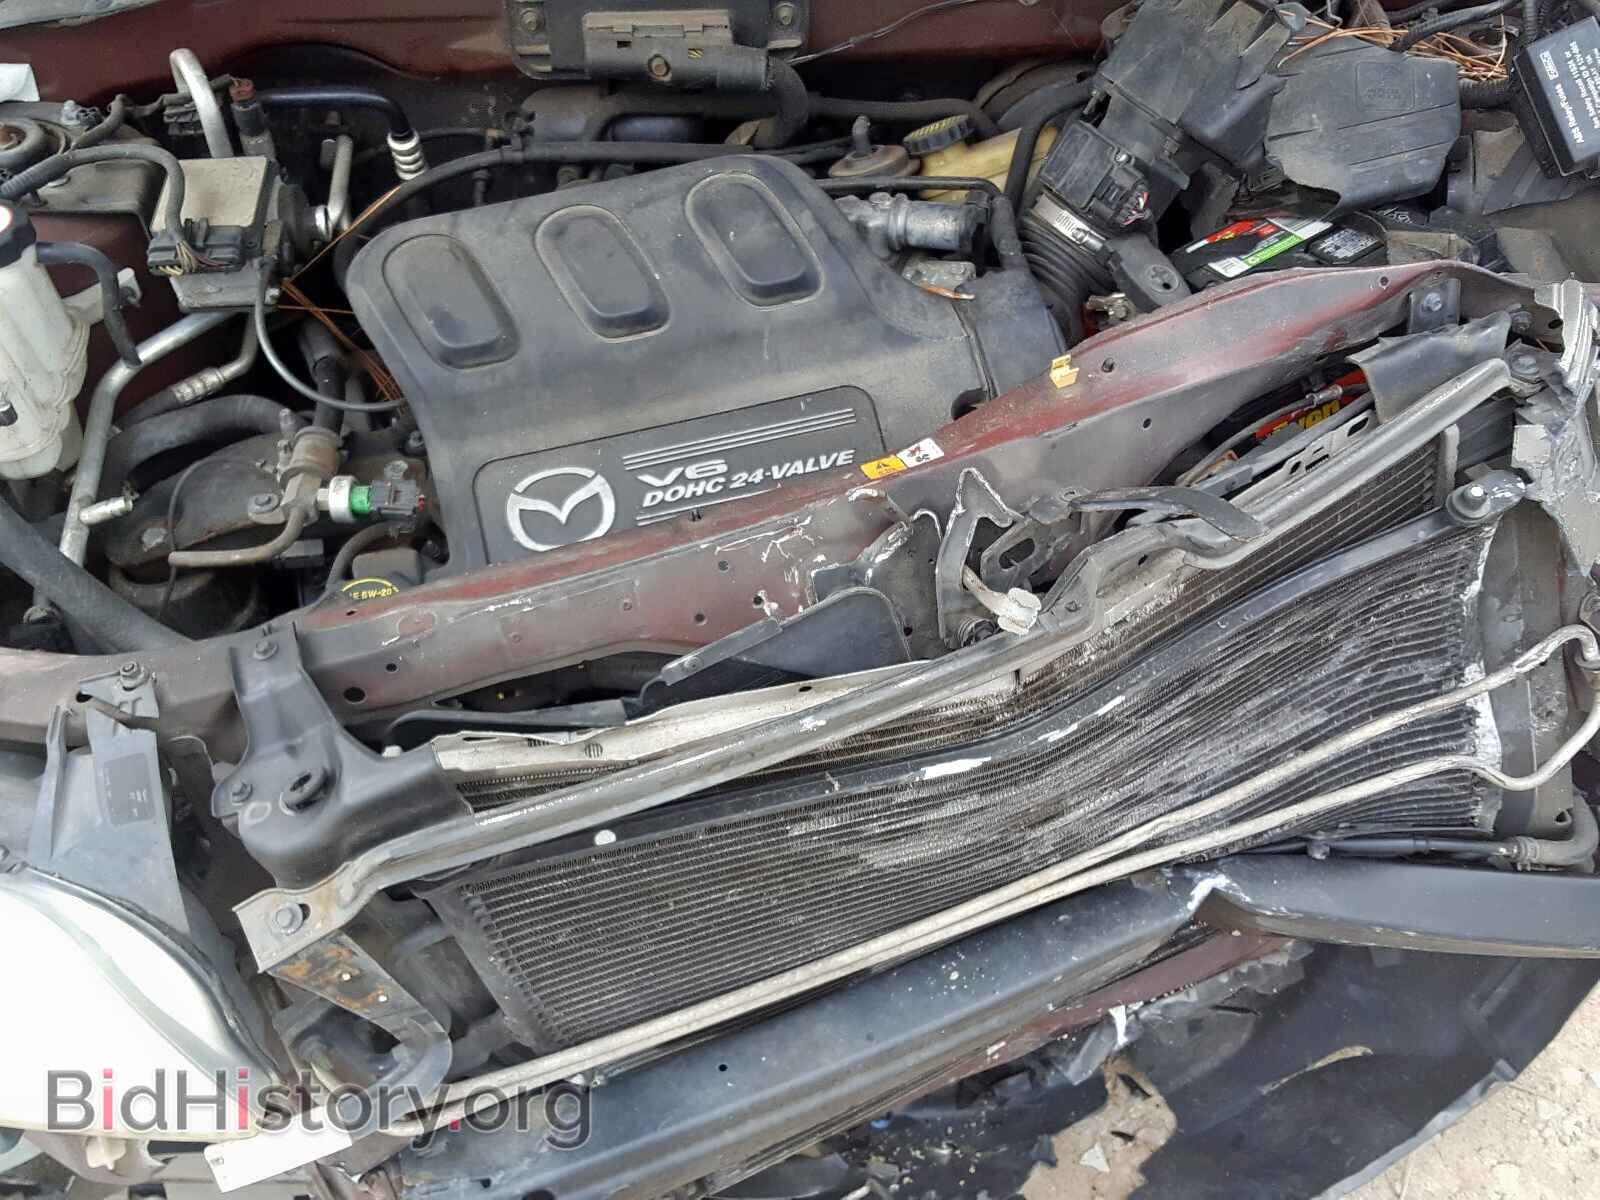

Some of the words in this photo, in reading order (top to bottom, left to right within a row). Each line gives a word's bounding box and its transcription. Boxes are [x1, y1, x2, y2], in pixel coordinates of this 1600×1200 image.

[637, 459, 728, 487] V6
[642, 477, 726, 508] DOHC
[729, 449, 856, 489] 24-VALVE
